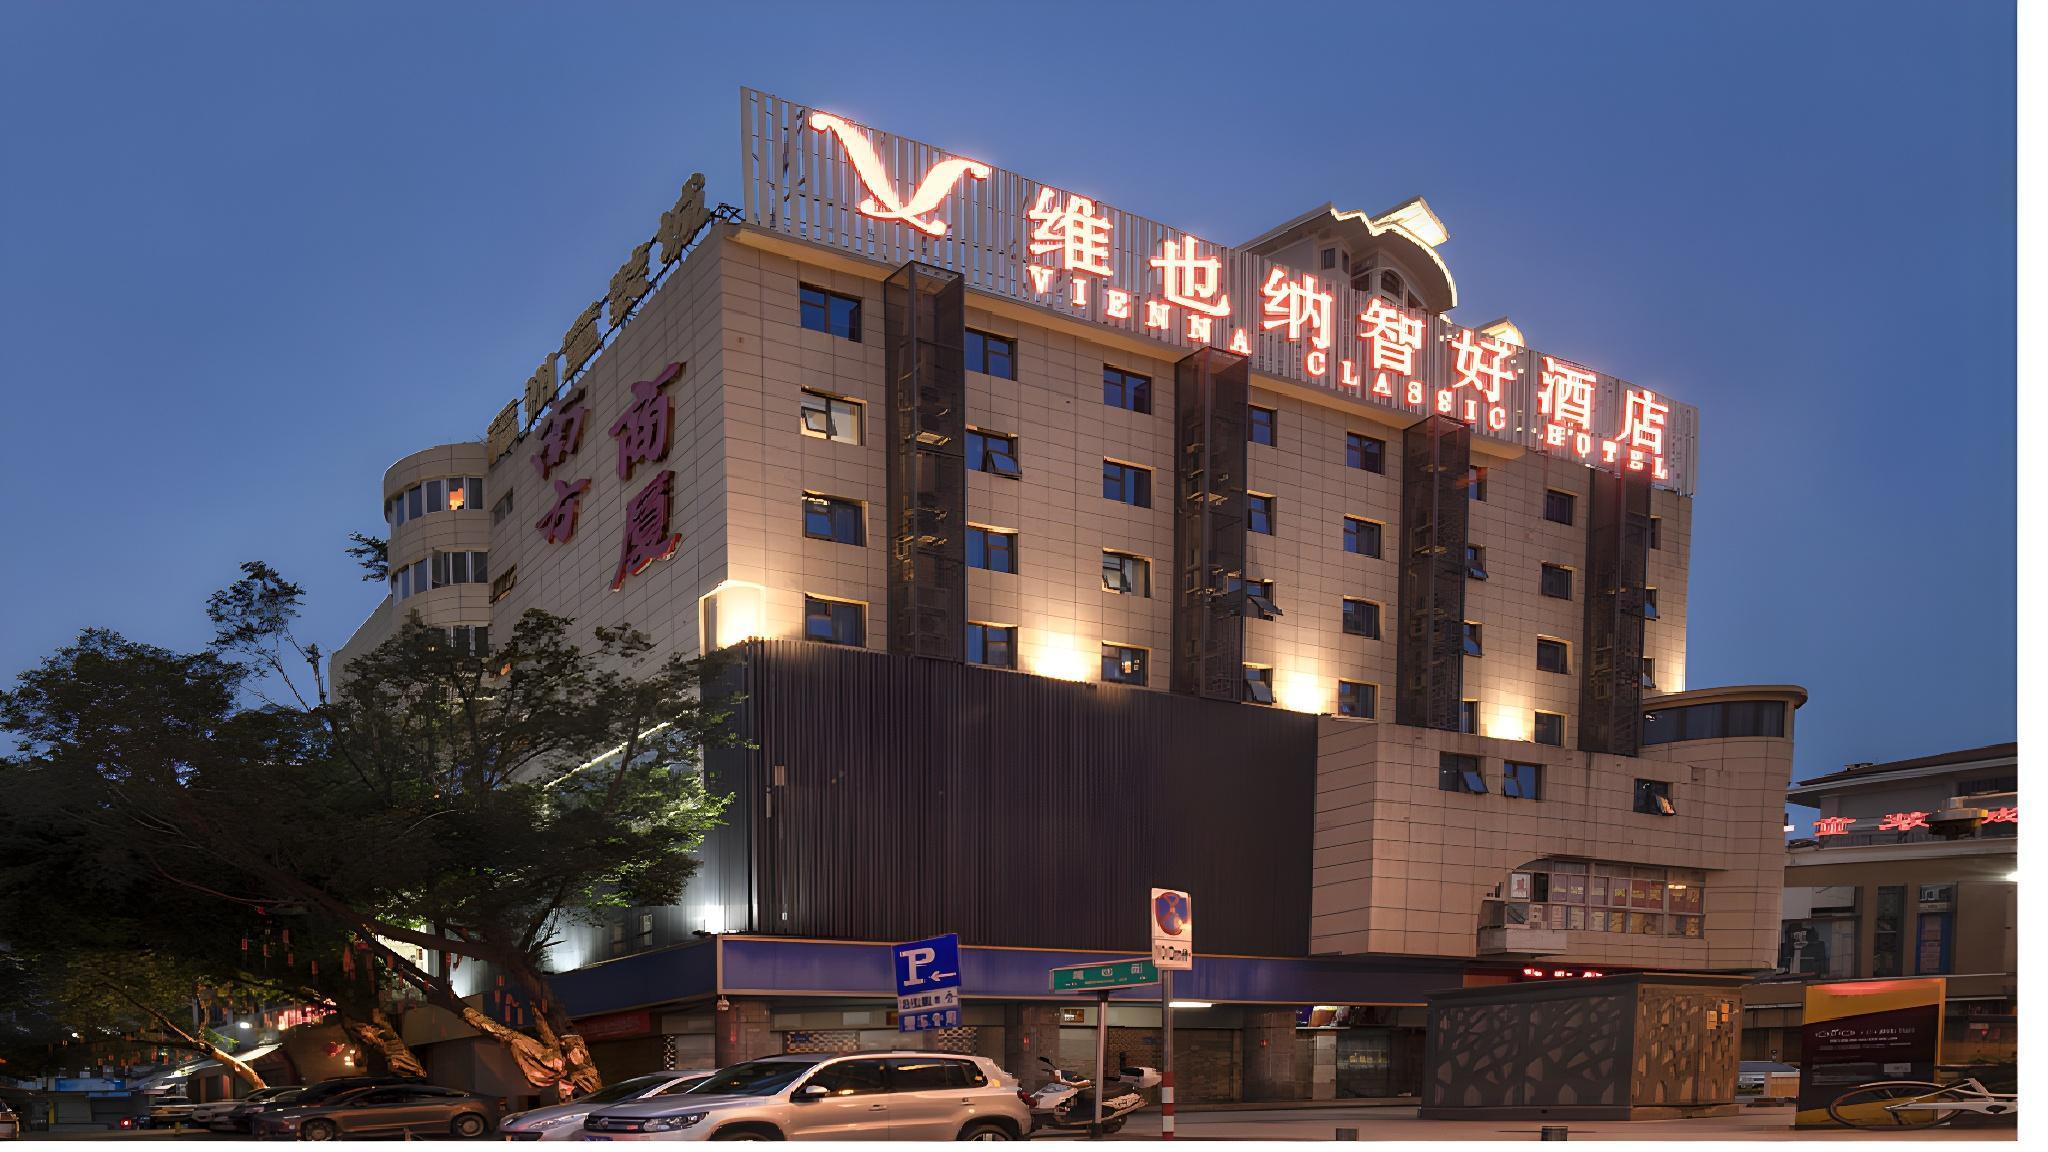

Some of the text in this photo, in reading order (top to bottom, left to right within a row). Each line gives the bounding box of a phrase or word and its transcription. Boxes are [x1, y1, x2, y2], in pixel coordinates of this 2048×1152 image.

[1026, 265, 1670, 480] VIENNA CLASSIC HOTEL
[1028, 186, 1671, 463] 维也纳智好酒店
[900, 947, 935, 986] P
